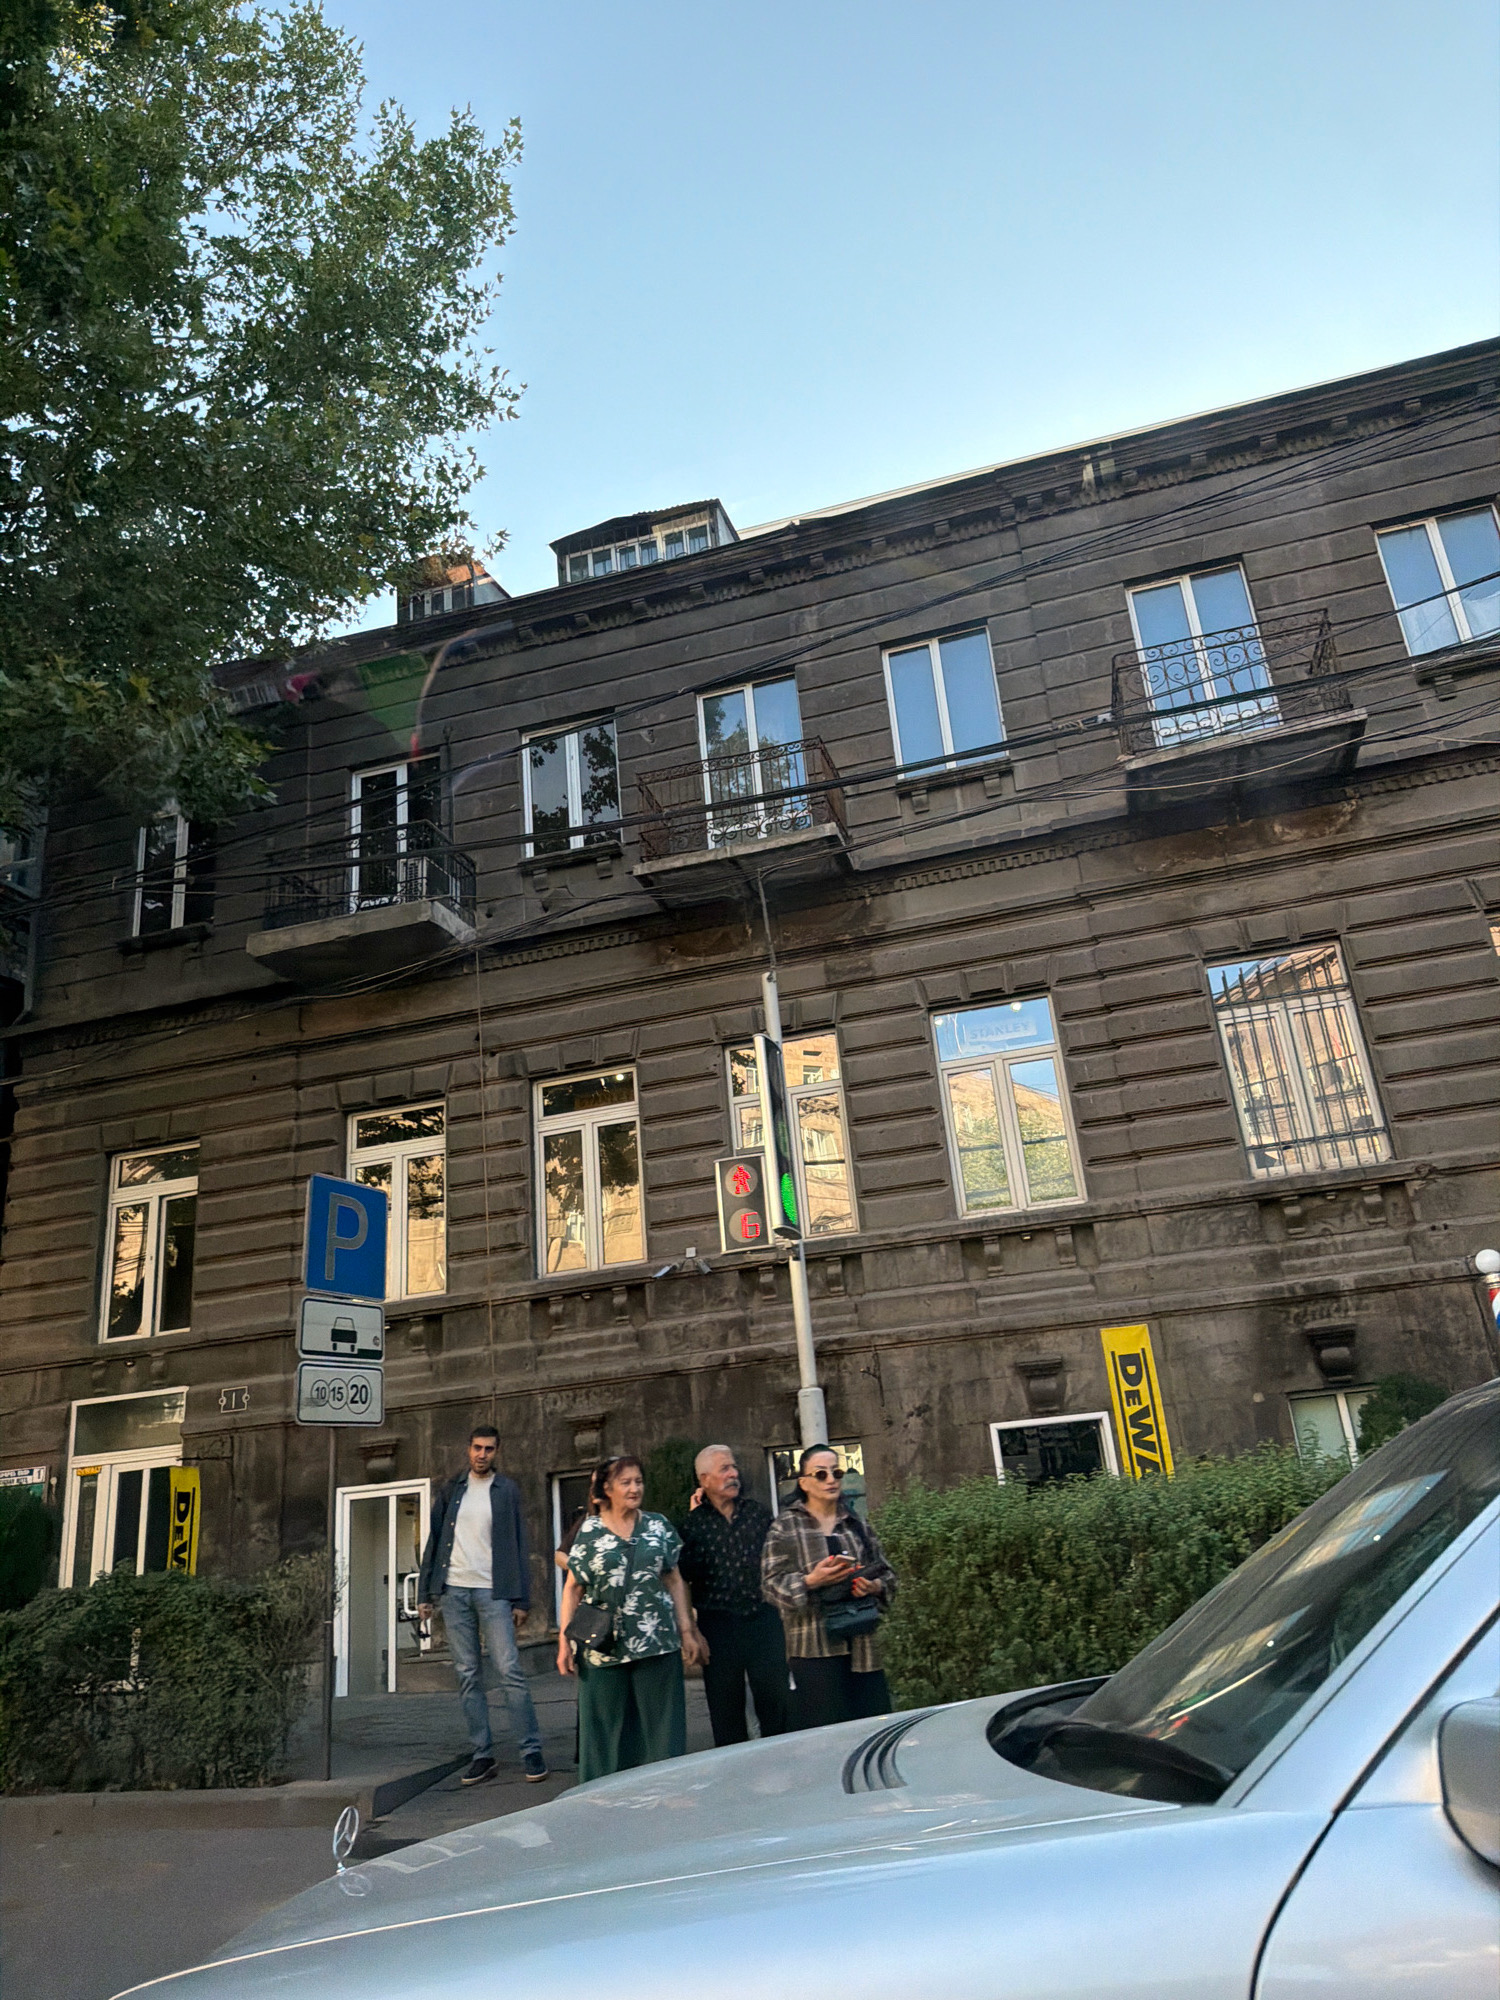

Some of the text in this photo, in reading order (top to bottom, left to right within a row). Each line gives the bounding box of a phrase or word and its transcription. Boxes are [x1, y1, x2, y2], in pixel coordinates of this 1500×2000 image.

[970, 1020, 1031, 1039] STANLEY
[325, 1192, 368, 1281] P
[740, 1211, 760, 1238] 6
[315, 1384, 369, 1405] 10 15 20
